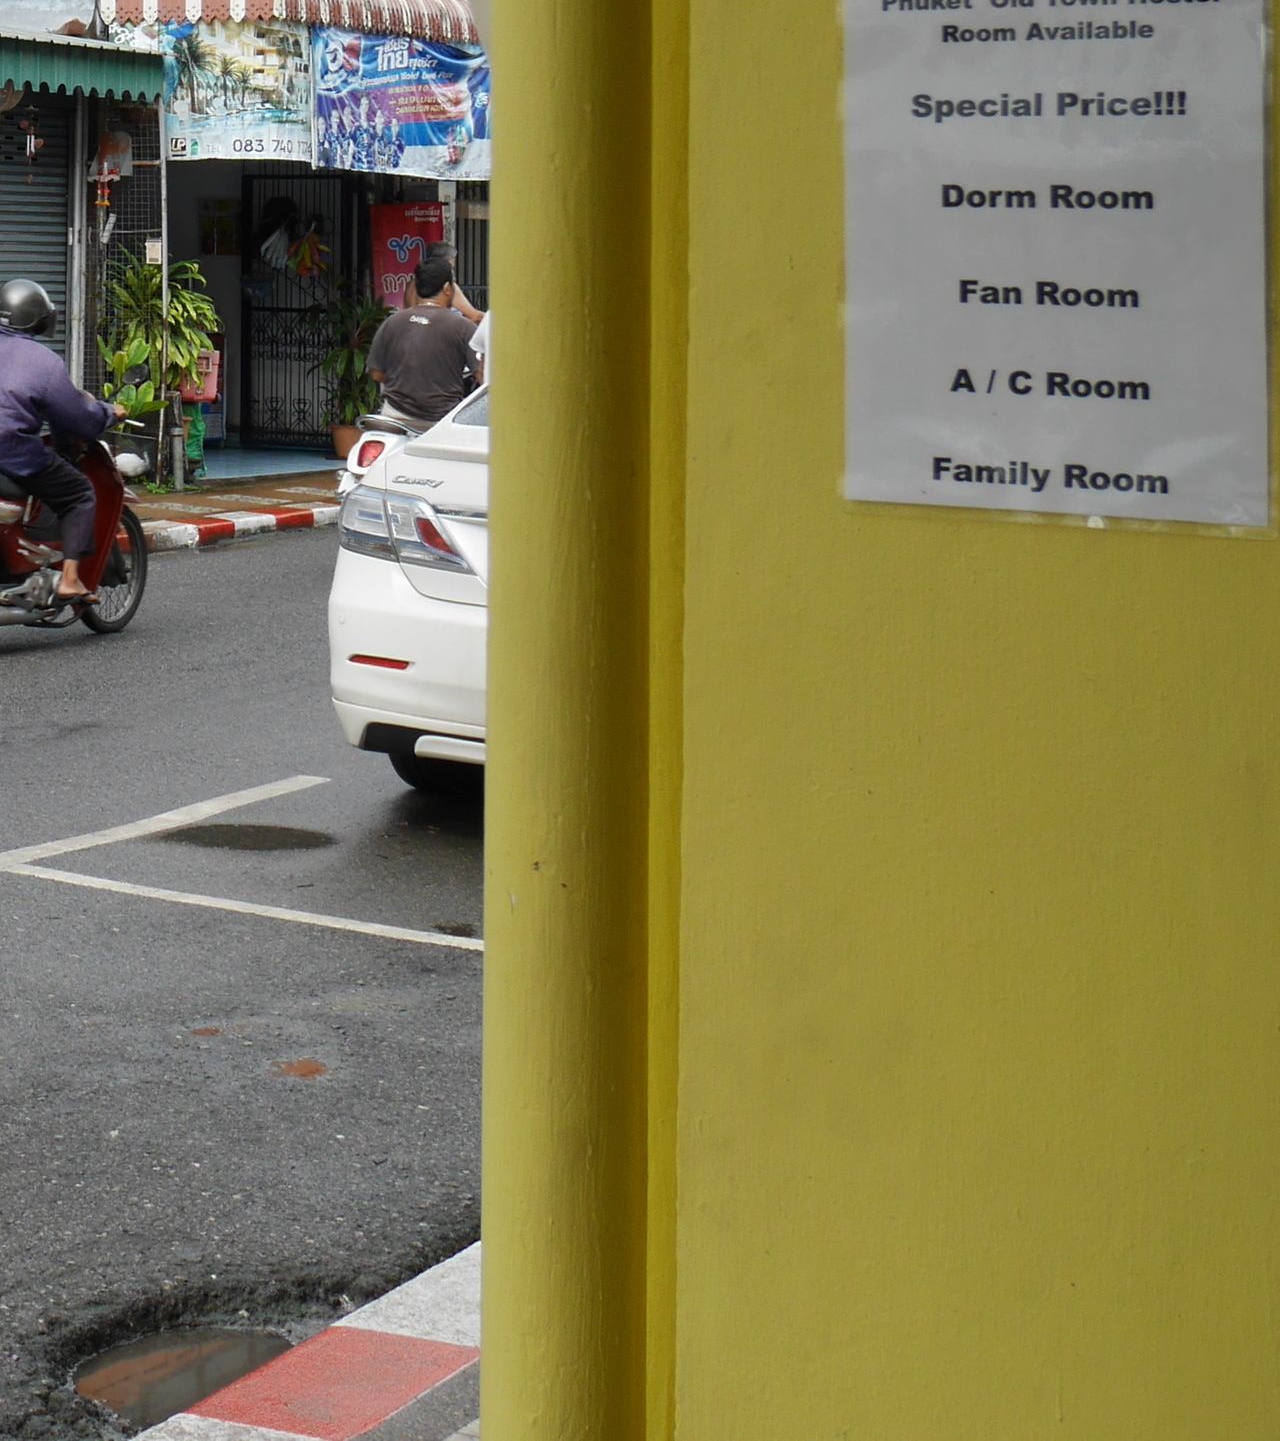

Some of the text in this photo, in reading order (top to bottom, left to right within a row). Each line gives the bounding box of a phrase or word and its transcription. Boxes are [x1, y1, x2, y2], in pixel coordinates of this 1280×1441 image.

[941, 19, 1155, 43] Room Available
[911, 90, 1187, 124] Special Price!!!
[232, 138, 265, 153] 083
[271, 138, 293, 154] 740
[941, 184, 1154, 210] Dorm Room
[959, 279, 1140, 308] Fan Room
[950, 368, 1150, 401] A / C Room
[932, 456, 1169, 495] Family Room
